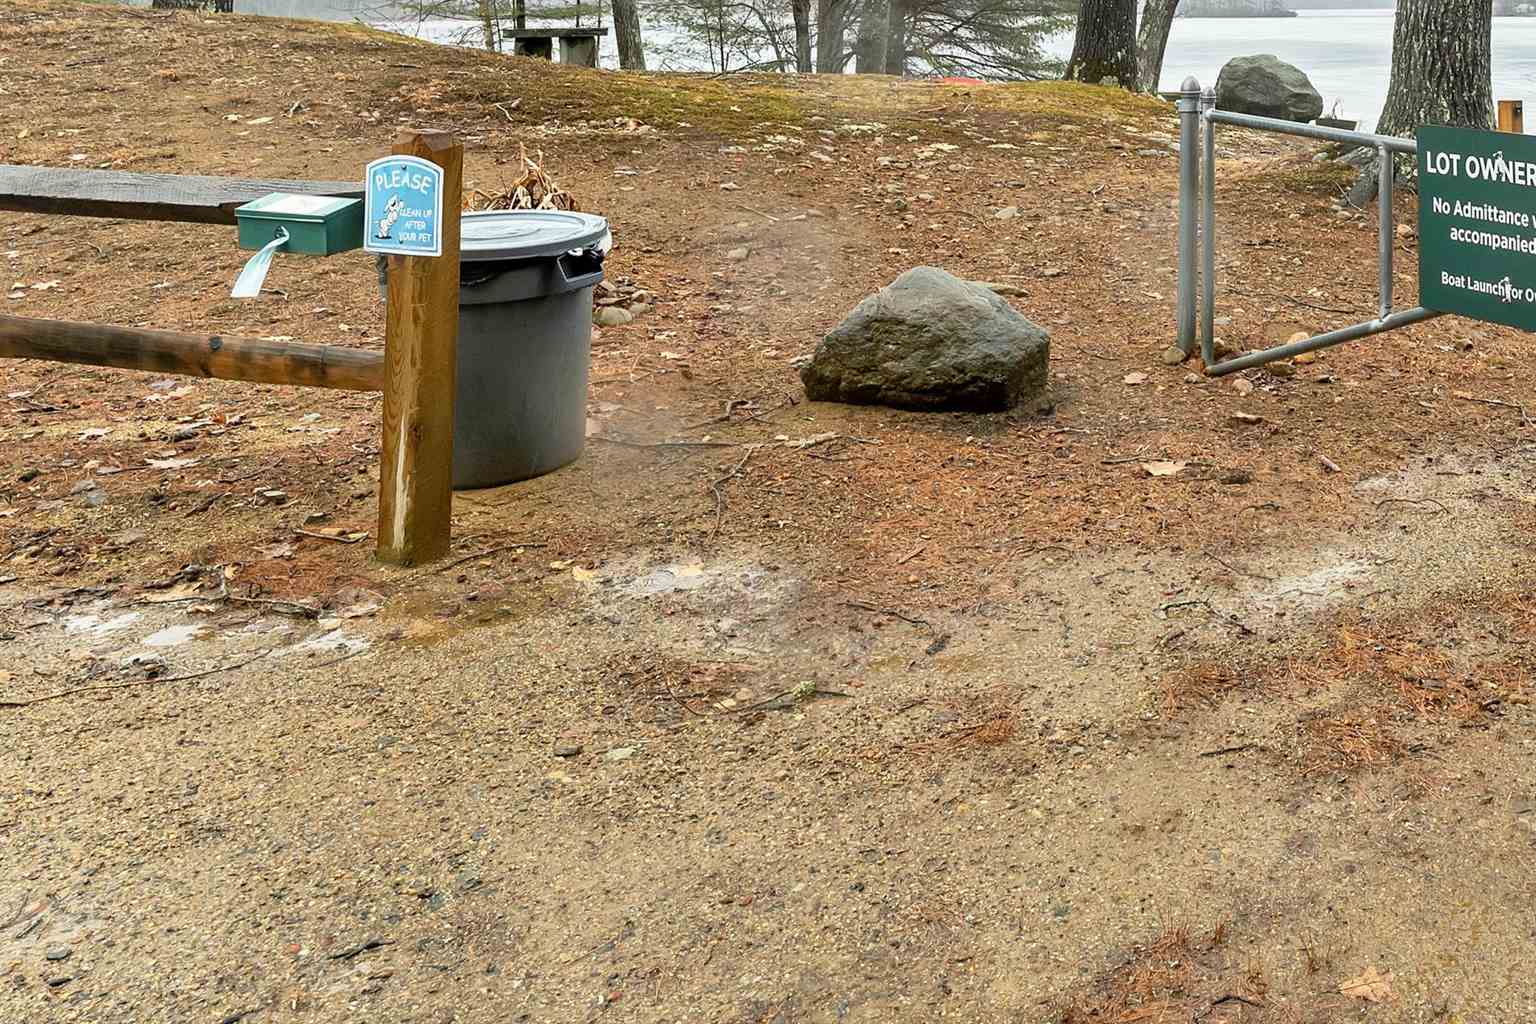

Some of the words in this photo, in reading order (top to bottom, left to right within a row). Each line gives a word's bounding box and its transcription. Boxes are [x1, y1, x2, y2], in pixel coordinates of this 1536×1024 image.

[1426, 151, 1460, 176] LOT
[376, 170, 432, 195] PLEASE
[1433, 197, 1450, 215] No
[1454, 200, 1529, 227] Admittance
[399, 232, 417, 241] YOUR
[418, 233, 432, 242] PET
[405, 221, 426, 230] AFTER
[1450, 227, 1536, 255] accompanied
[1441, 272, 1465, 289] Boat
[1467, 277, 1504, 296] Launch
[1505, 283, 1523, 300] for
